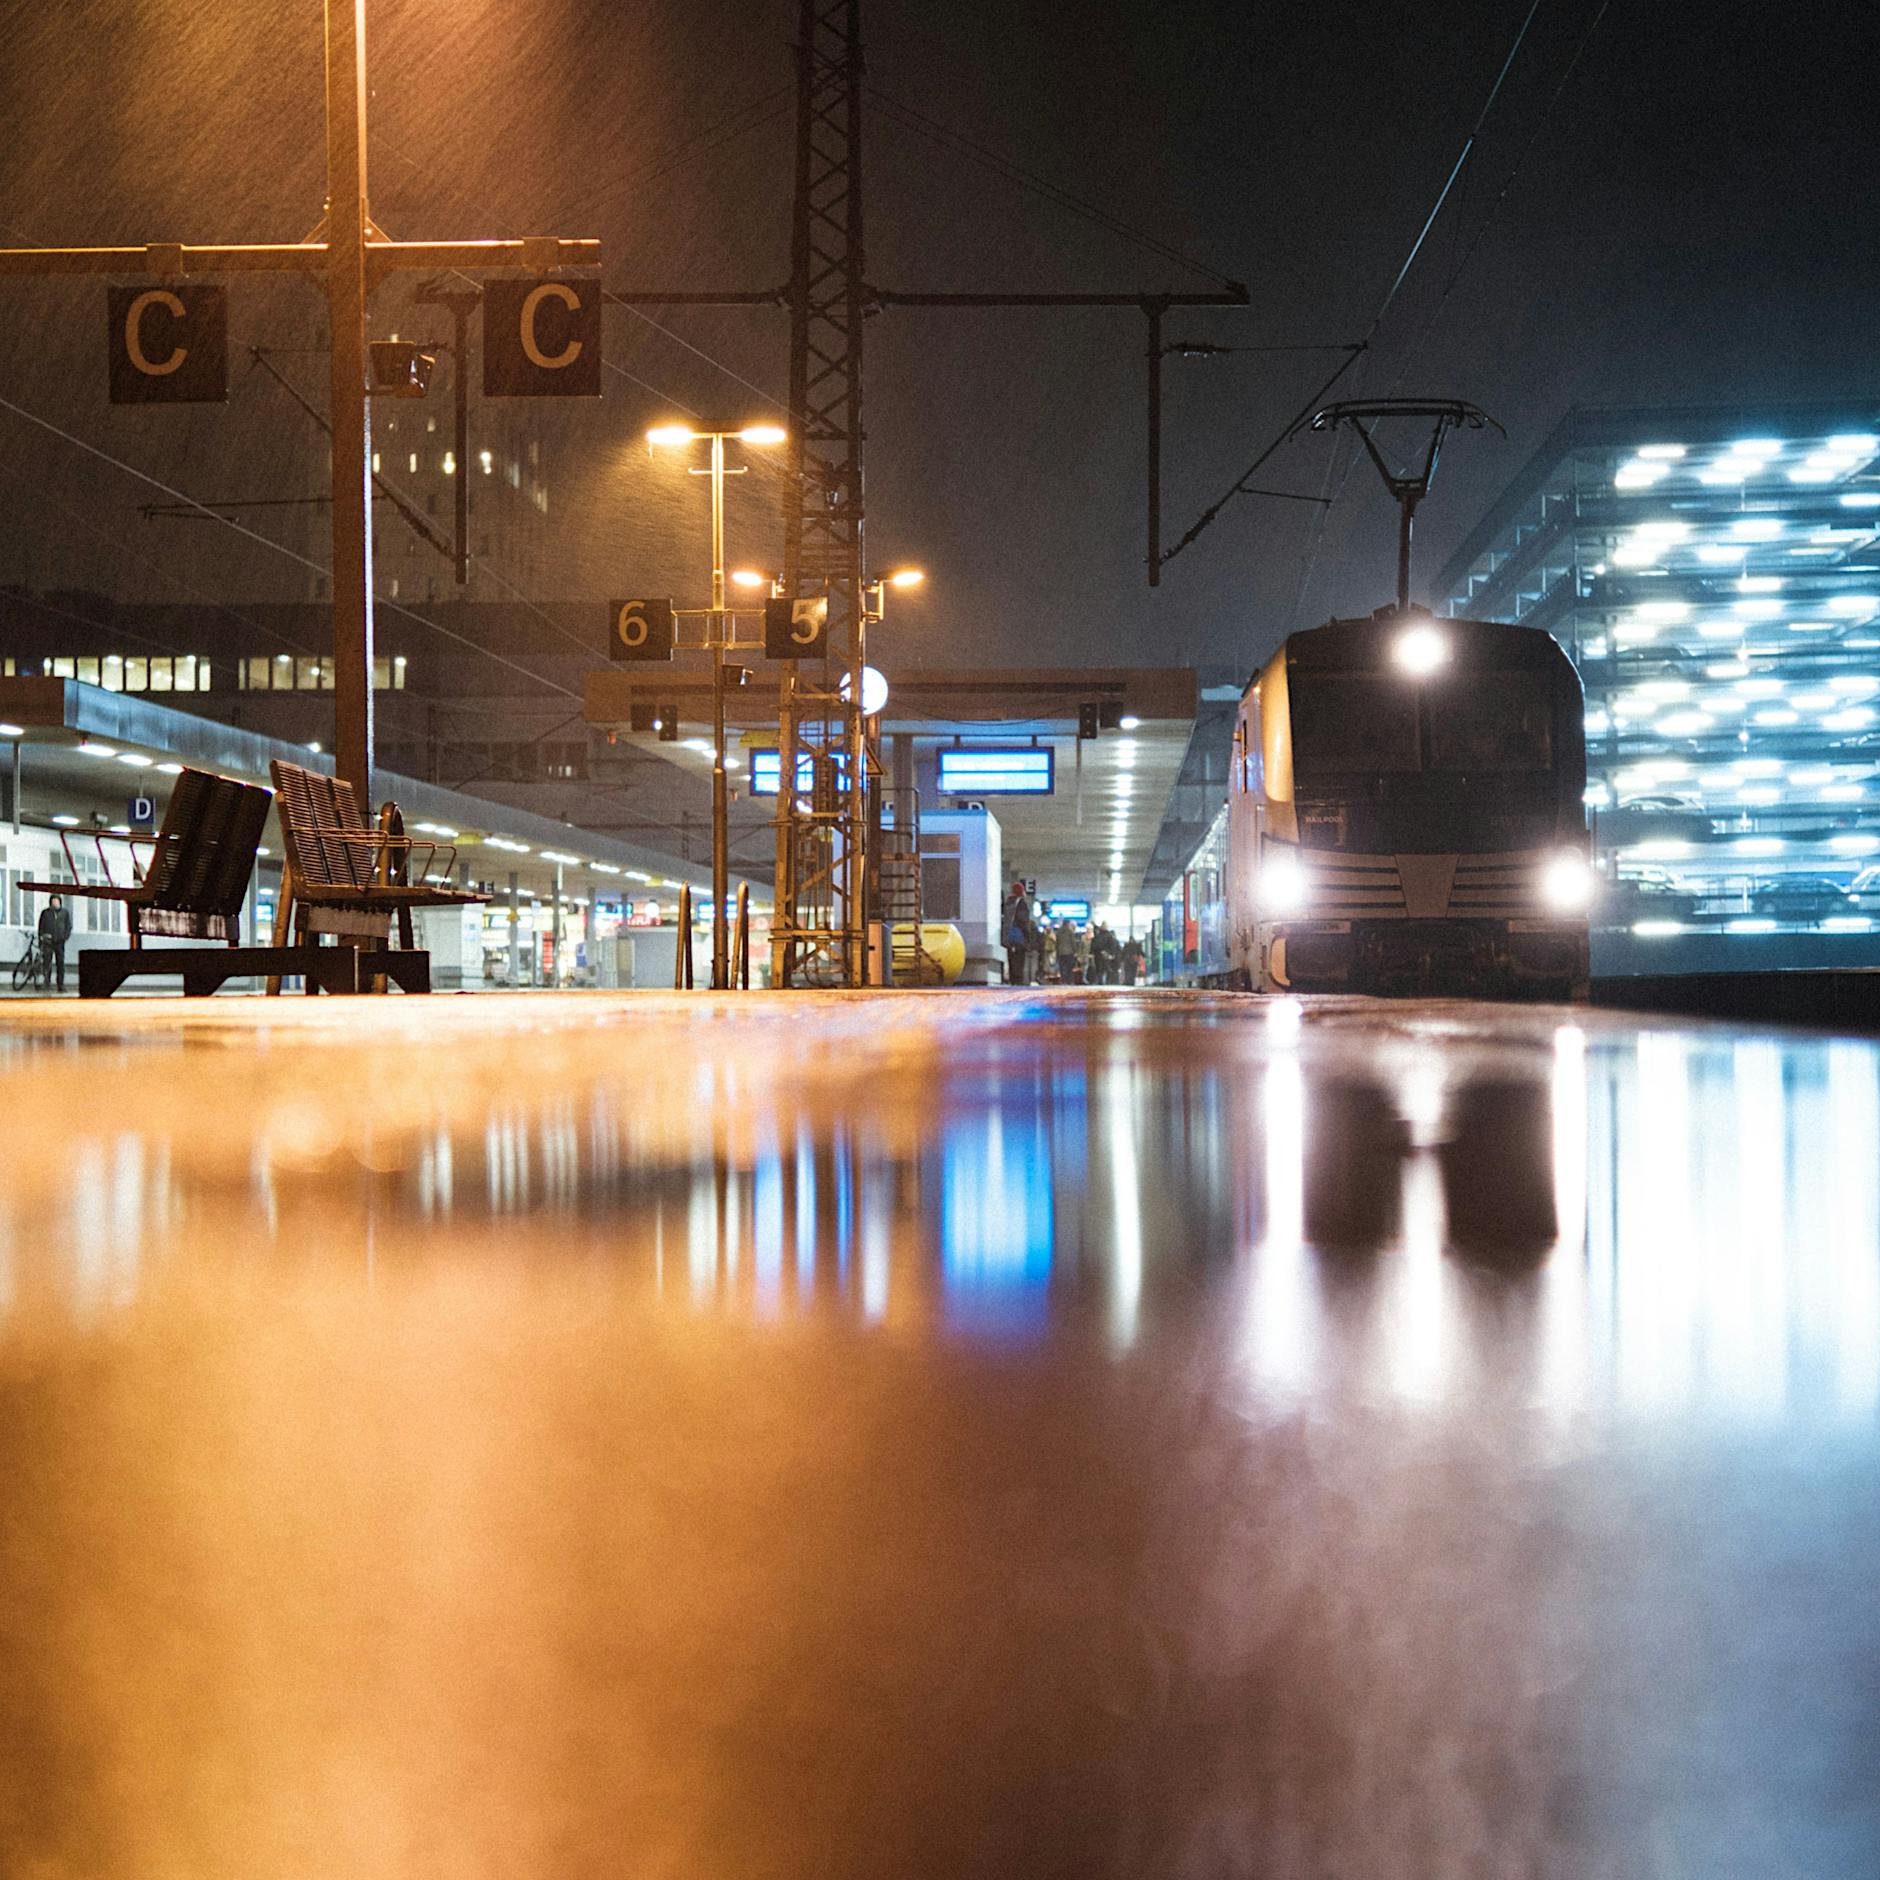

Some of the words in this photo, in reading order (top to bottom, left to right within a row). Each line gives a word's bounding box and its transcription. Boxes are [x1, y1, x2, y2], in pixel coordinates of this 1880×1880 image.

[125, 290, 188, 376] C
[521, 283, 582, 369] C
[618, 600, 648, 647] 6
[790, 599, 825, 644] 5
[135, 797, 151, 820] D
[1026, 879, 1034, 892] E
